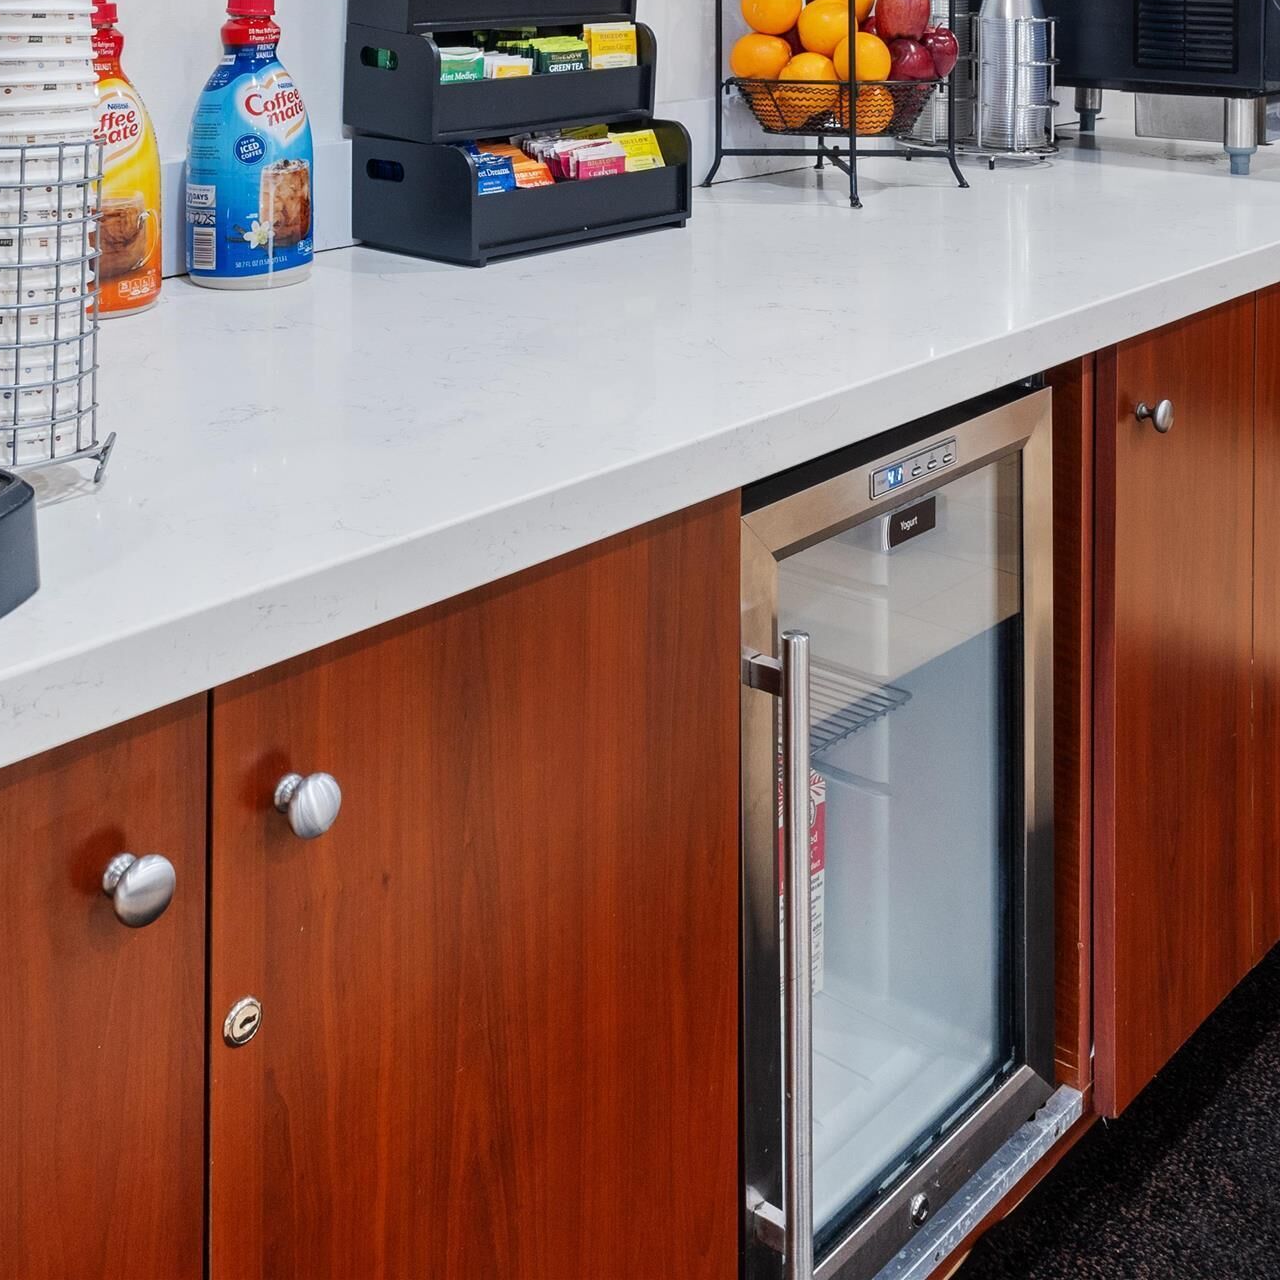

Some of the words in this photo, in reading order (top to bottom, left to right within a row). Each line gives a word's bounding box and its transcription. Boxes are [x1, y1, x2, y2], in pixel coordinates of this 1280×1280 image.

[548, 63, 571, 72] GREEN
[572, 62, 584, 71] TEA
[244, 88, 299, 116] Coffee
[99, 110, 136, 132] ffee
[267, 100, 304, 126] mate
[239, 143, 260, 154] ICED
[241, 150, 263, 160] COFFEE
[888, 467, 902, 484] 41
[900, 516, 918, 531] Yogurt
